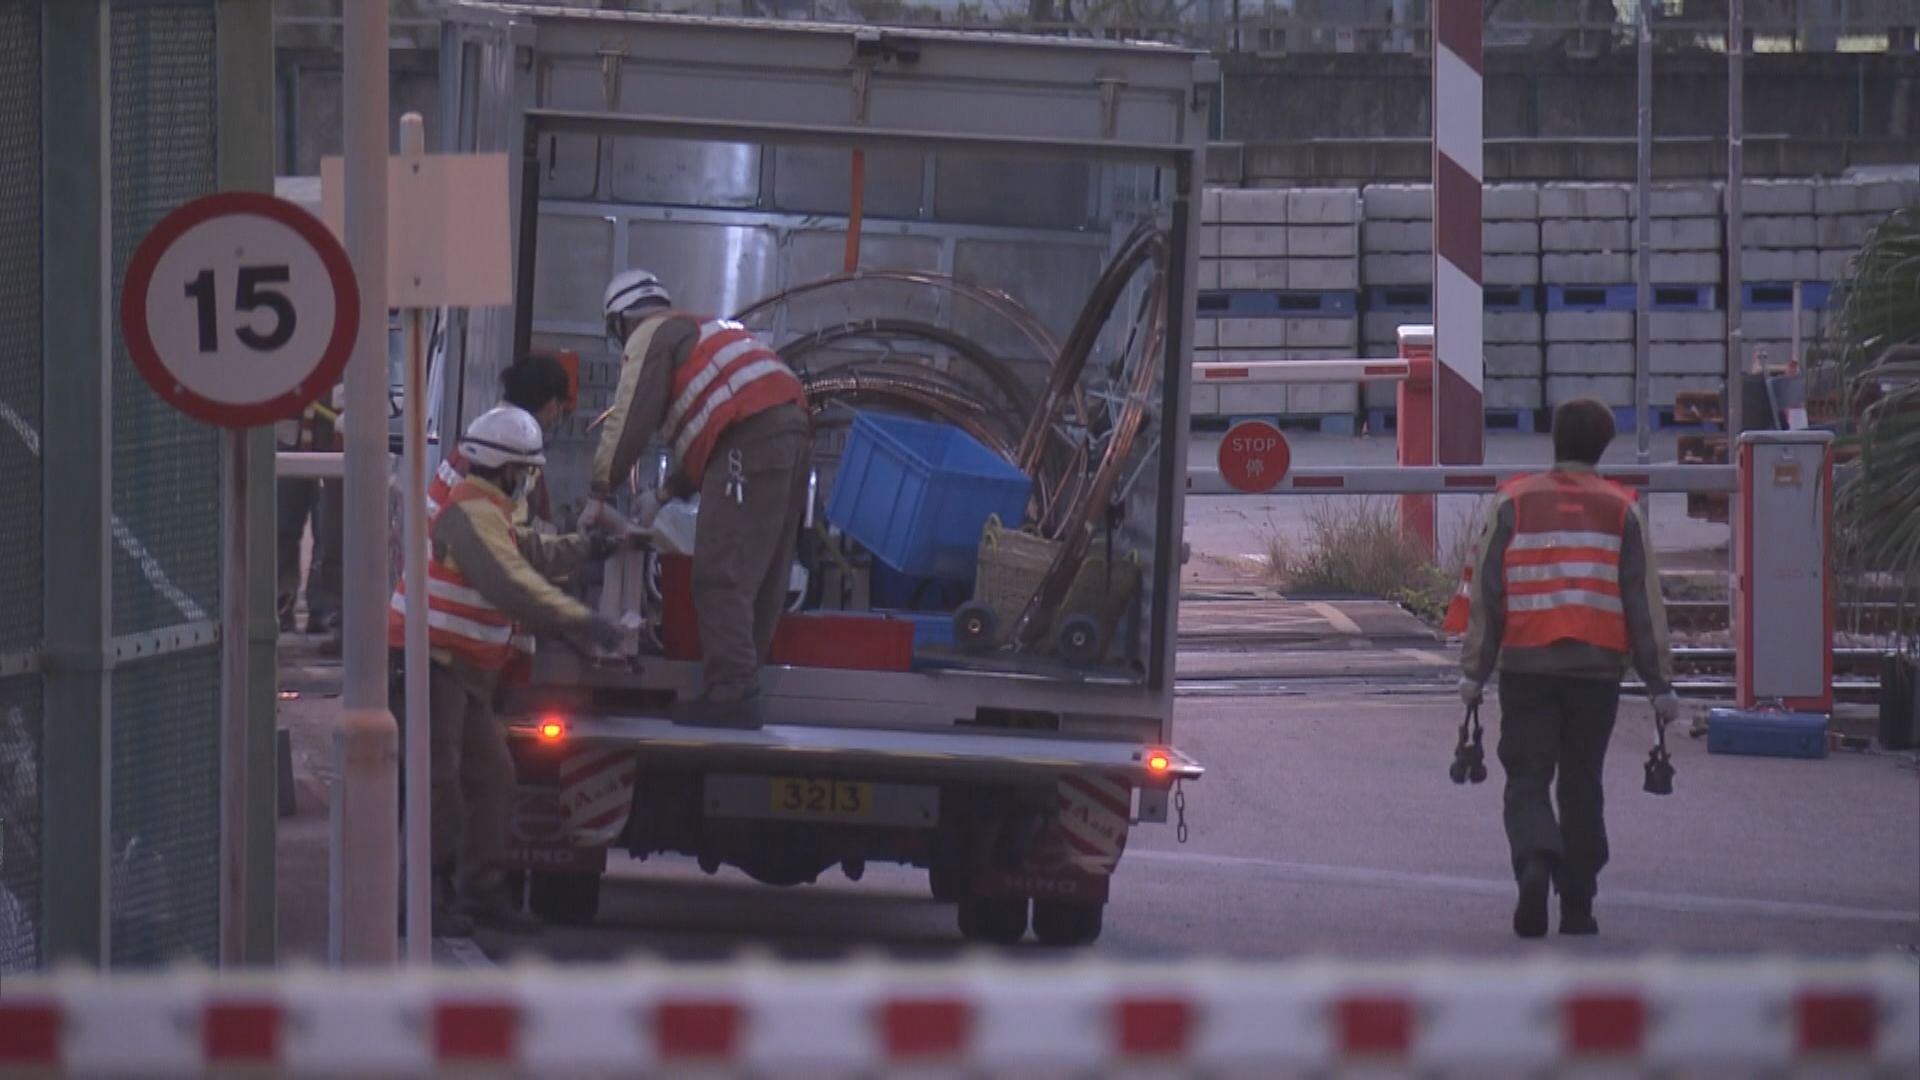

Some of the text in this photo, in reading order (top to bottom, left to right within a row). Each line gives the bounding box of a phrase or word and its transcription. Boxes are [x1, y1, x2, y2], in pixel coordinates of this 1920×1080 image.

[184, 264, 297, 353] 15
[1232, 438, 1276, 452] STOP
[783, 783, 860, 812] 3213
